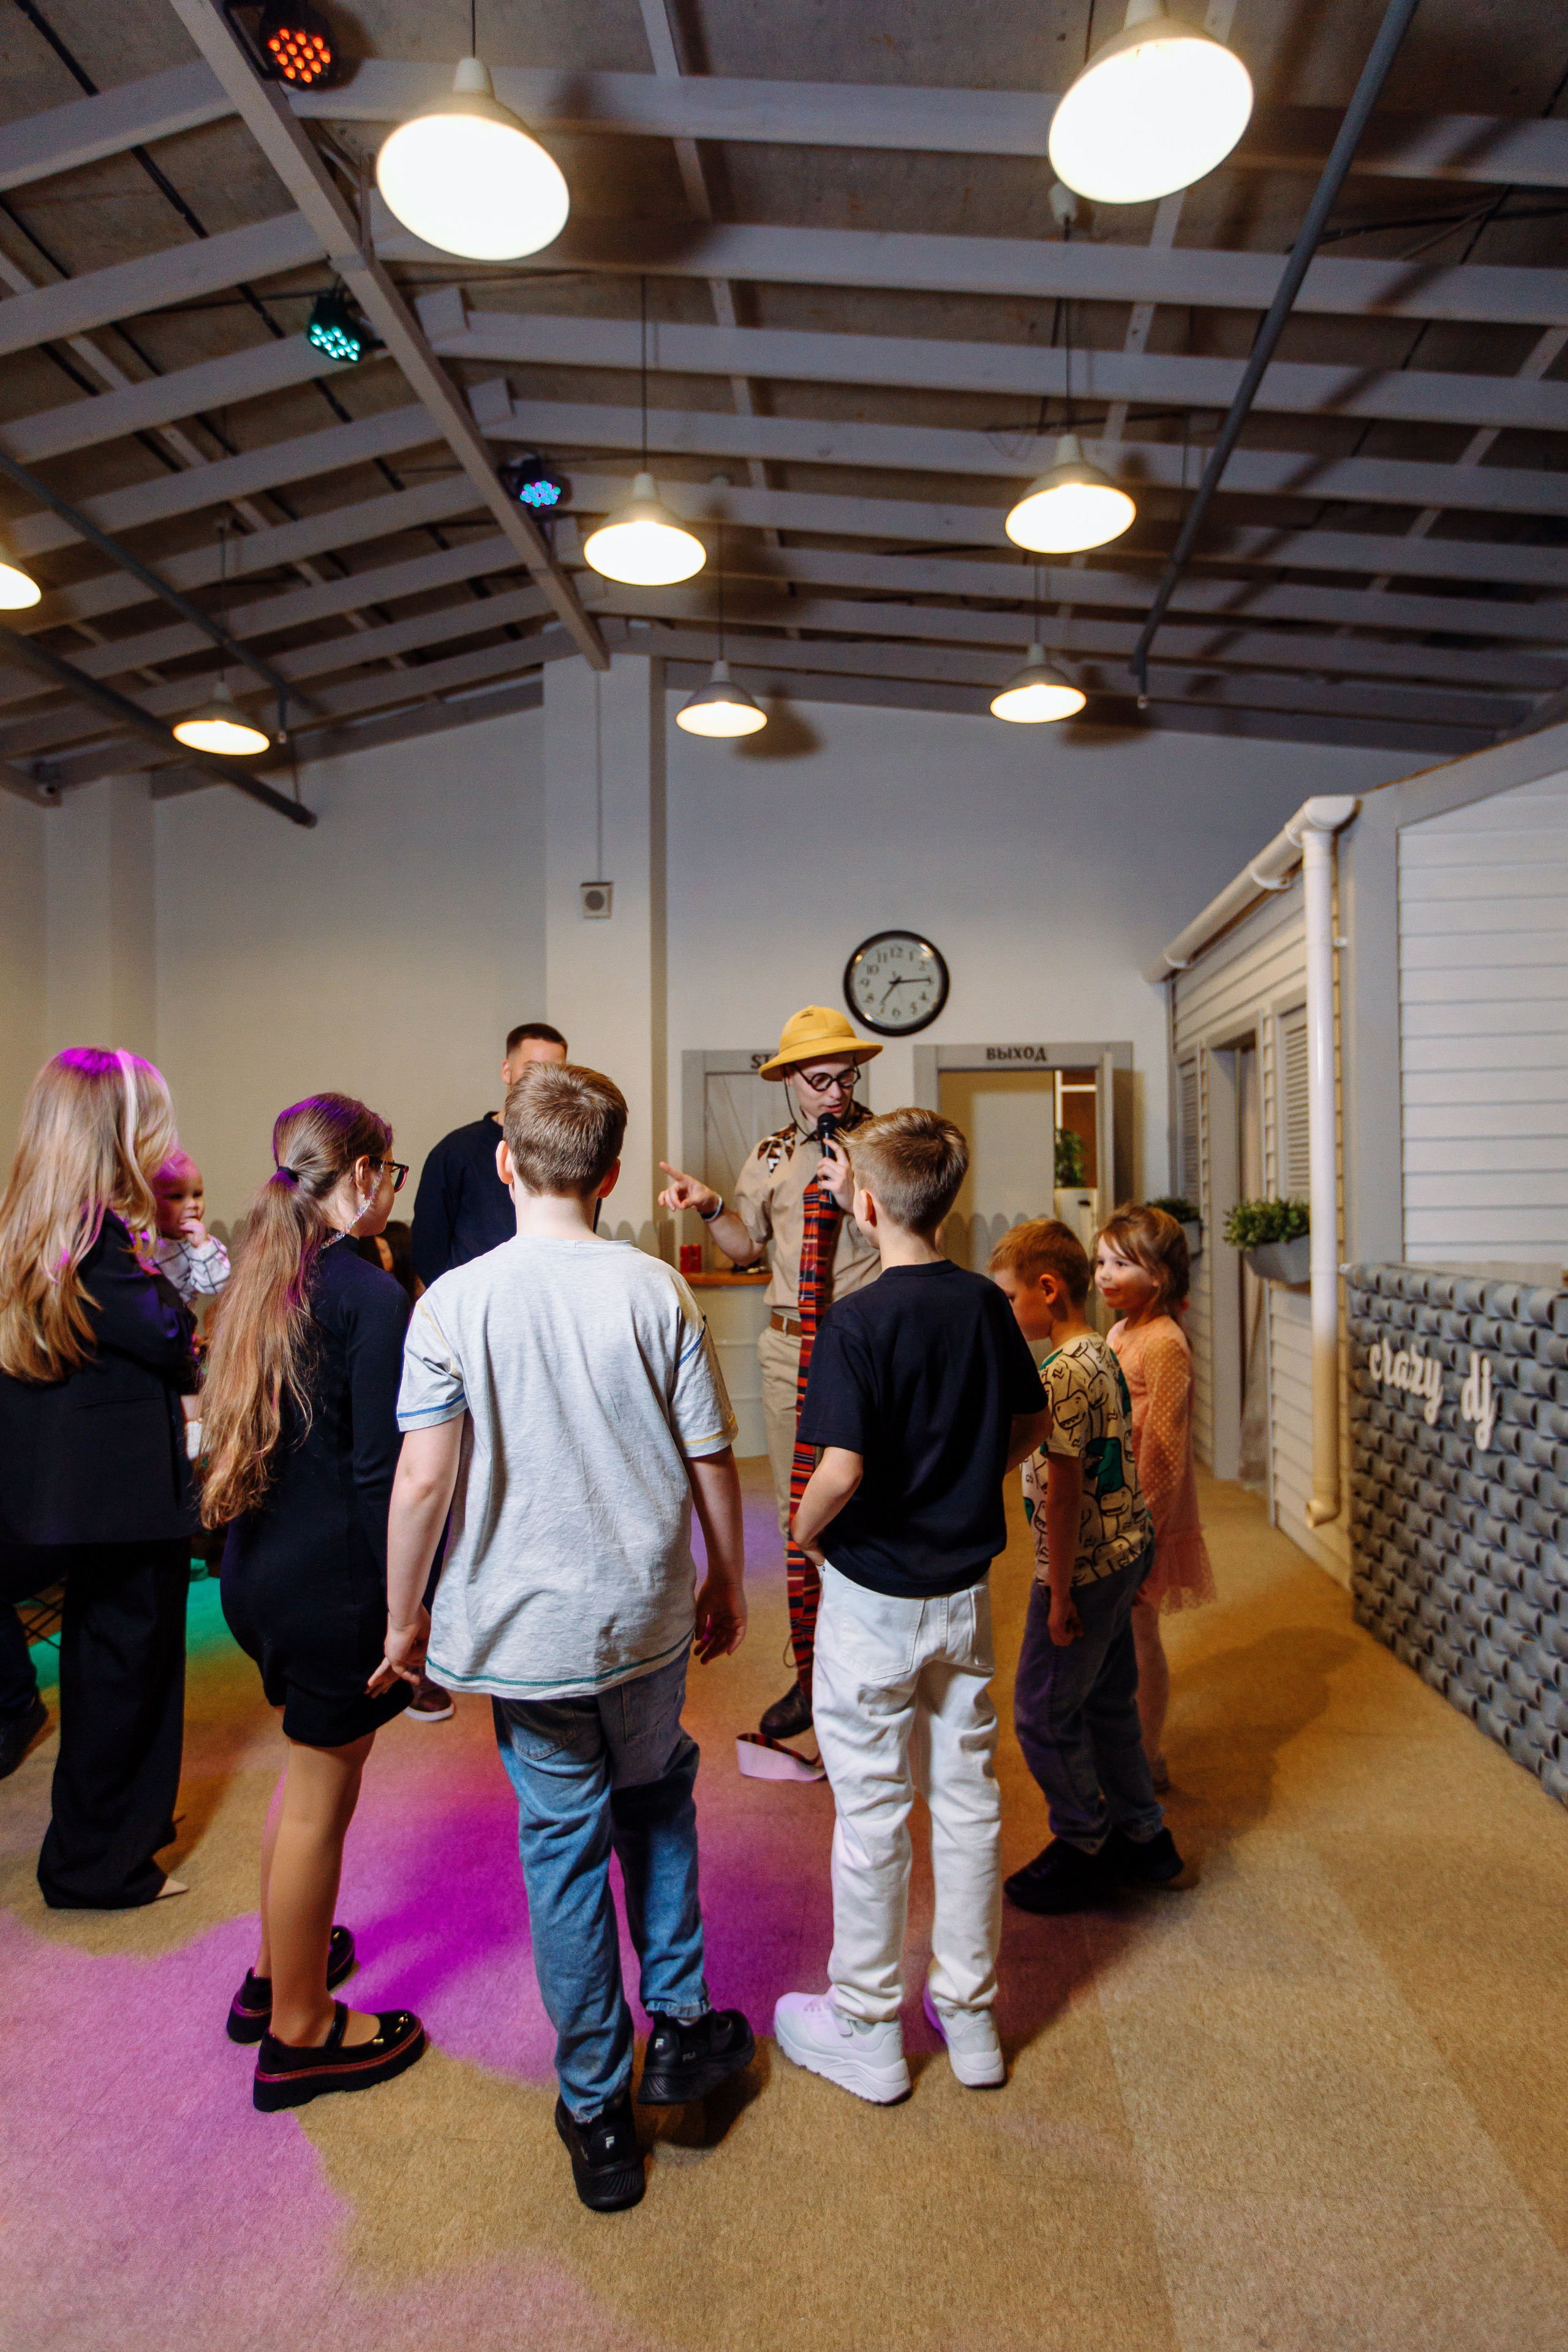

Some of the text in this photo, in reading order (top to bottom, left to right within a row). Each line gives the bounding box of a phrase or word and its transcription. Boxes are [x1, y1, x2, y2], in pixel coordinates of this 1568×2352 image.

[751, 1054, 772, 1069] ST
[986, 1046, 1048, 1062] ВЫХОД
[1368, 1337, 1496, 1451] crazy dj
